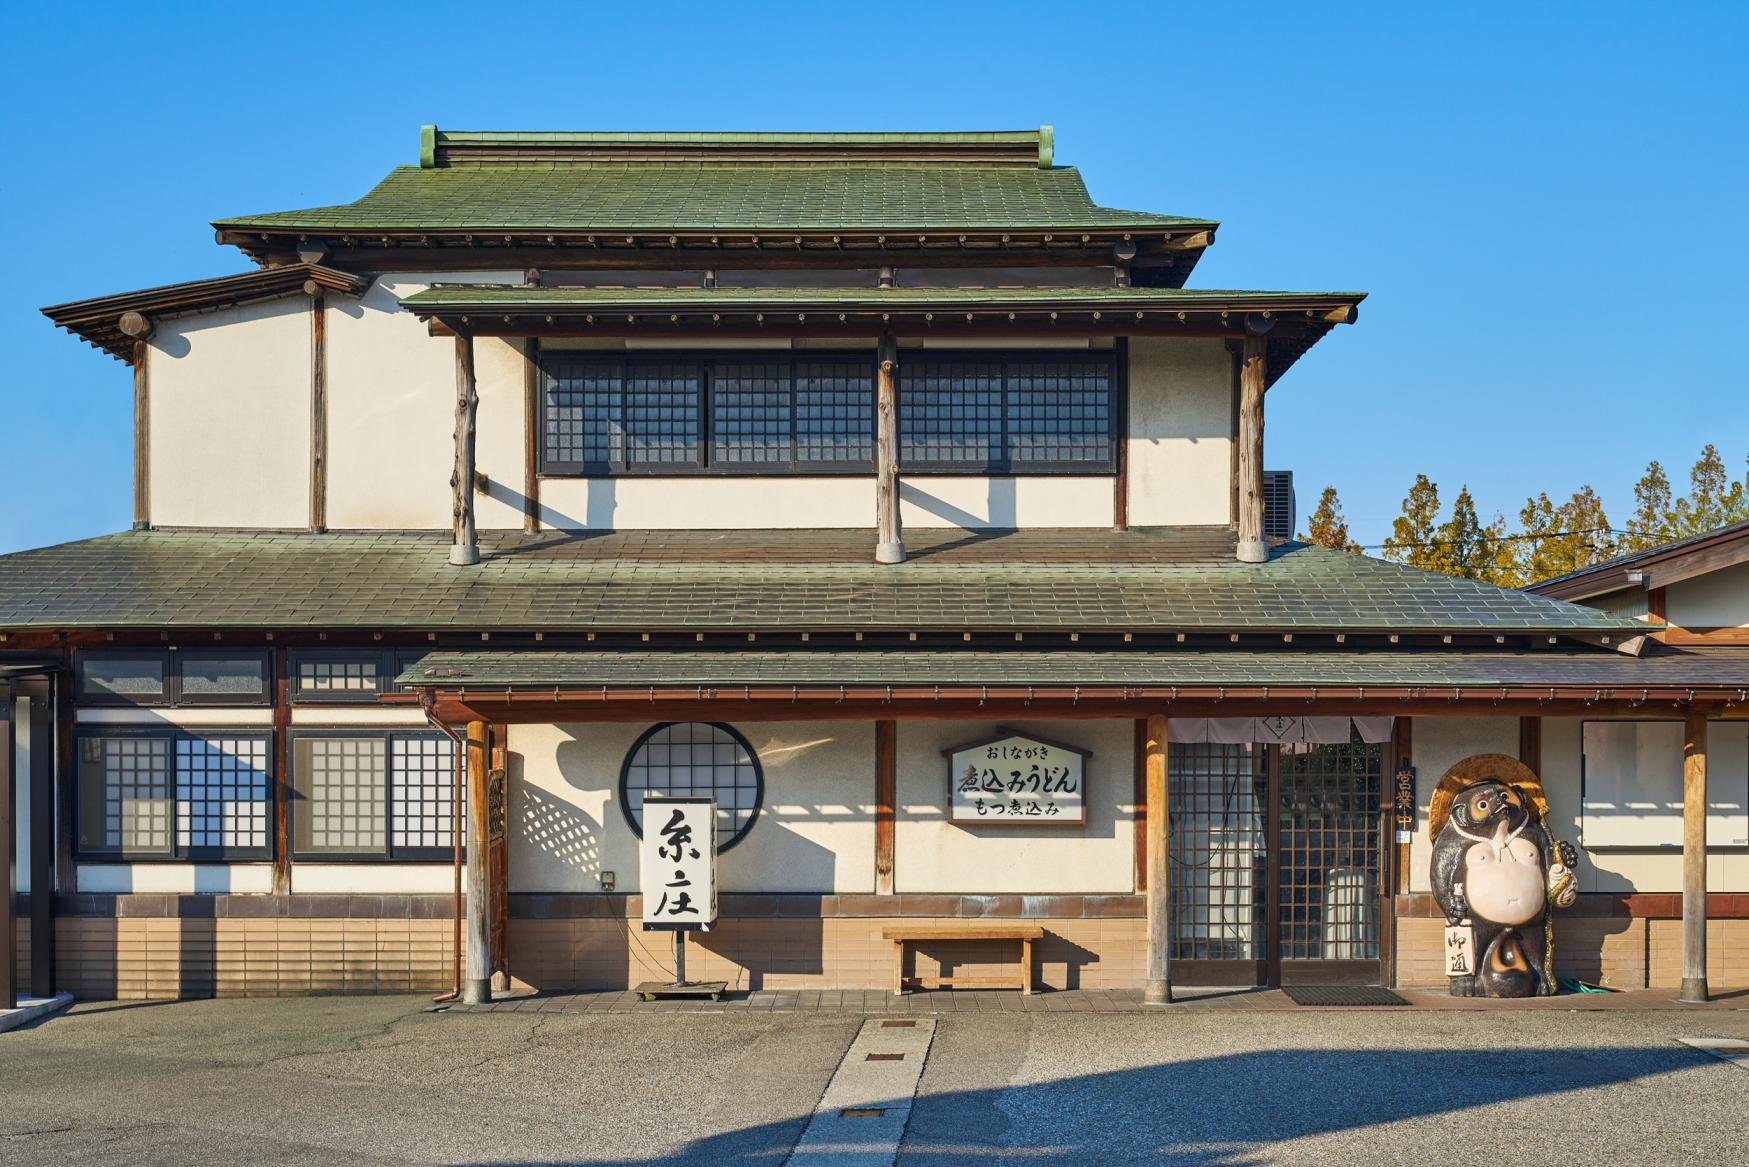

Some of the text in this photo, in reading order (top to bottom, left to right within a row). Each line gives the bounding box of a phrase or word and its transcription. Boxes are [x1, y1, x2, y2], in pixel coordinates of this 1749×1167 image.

[986, 746, 1048, 760] おしながき
[958, 764, 1077, 793] 煮込みうどん
[975, 798, 1060, 816] もつ煮込み
[1396, 770, 1414, 830] 営業中
[653, 808, 700, 916] 糸庄
